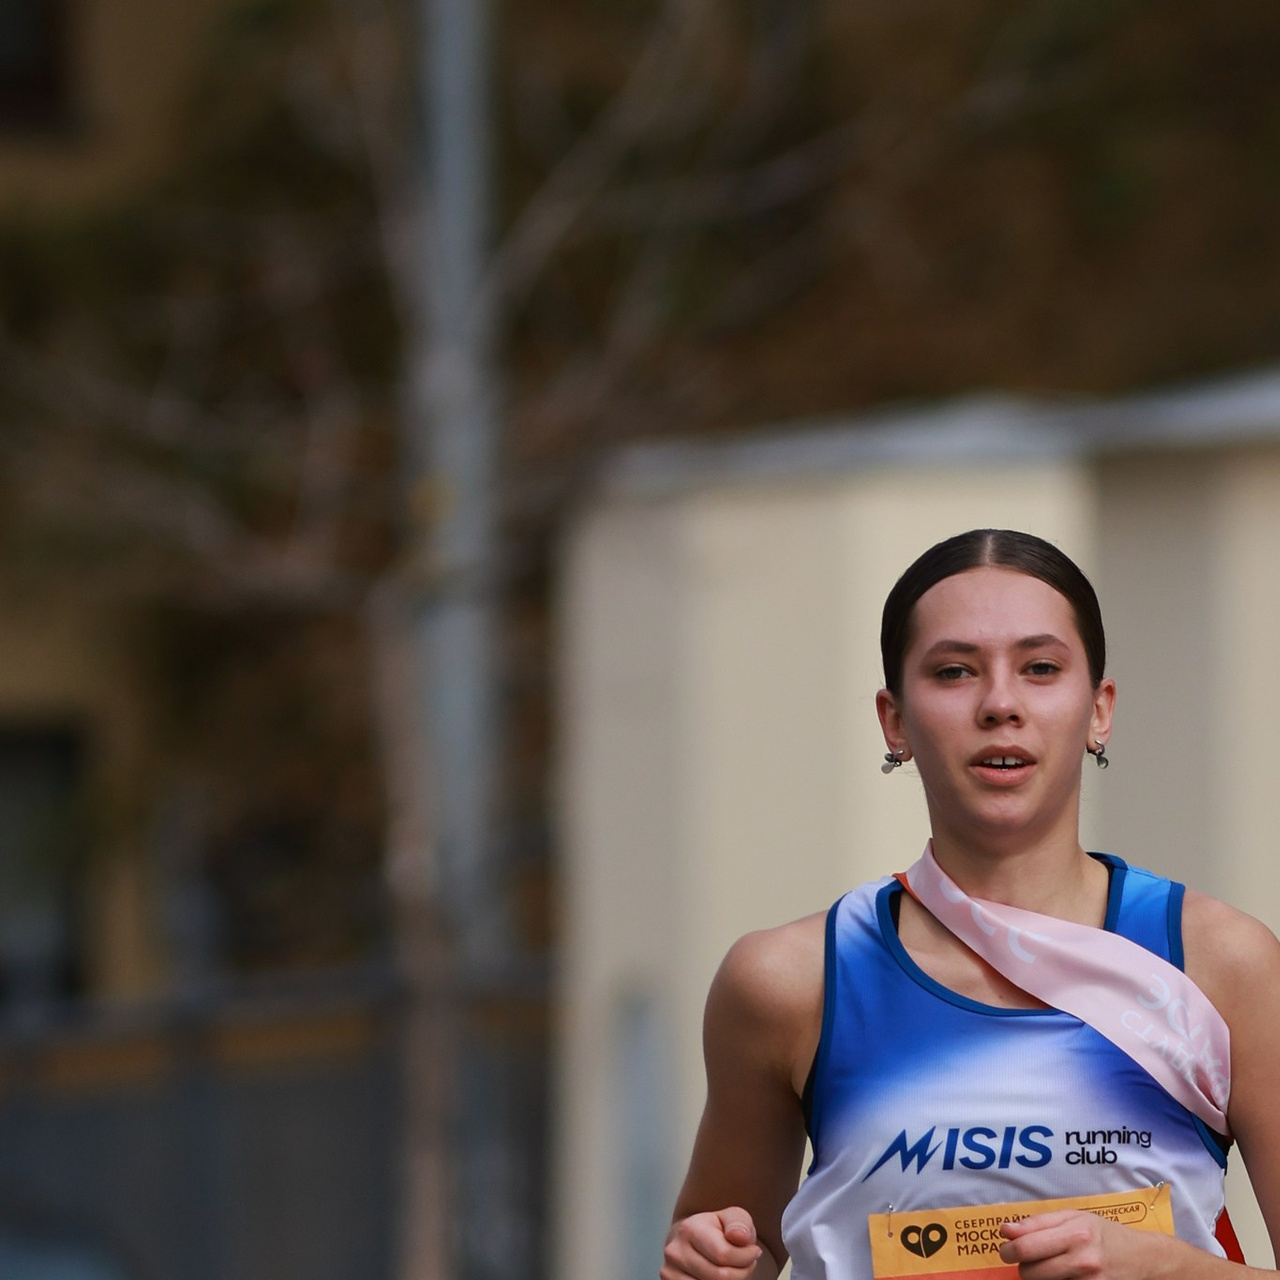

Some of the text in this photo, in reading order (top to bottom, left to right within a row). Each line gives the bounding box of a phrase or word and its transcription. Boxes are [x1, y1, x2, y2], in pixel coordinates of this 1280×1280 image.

[1065, 1126, 1152, 1148] running
[1065, 1146, 1118, 1165] club
[956, 1229, 1004, 1243] МОСК
[957, 1242, 1003, 1256] МАРА
